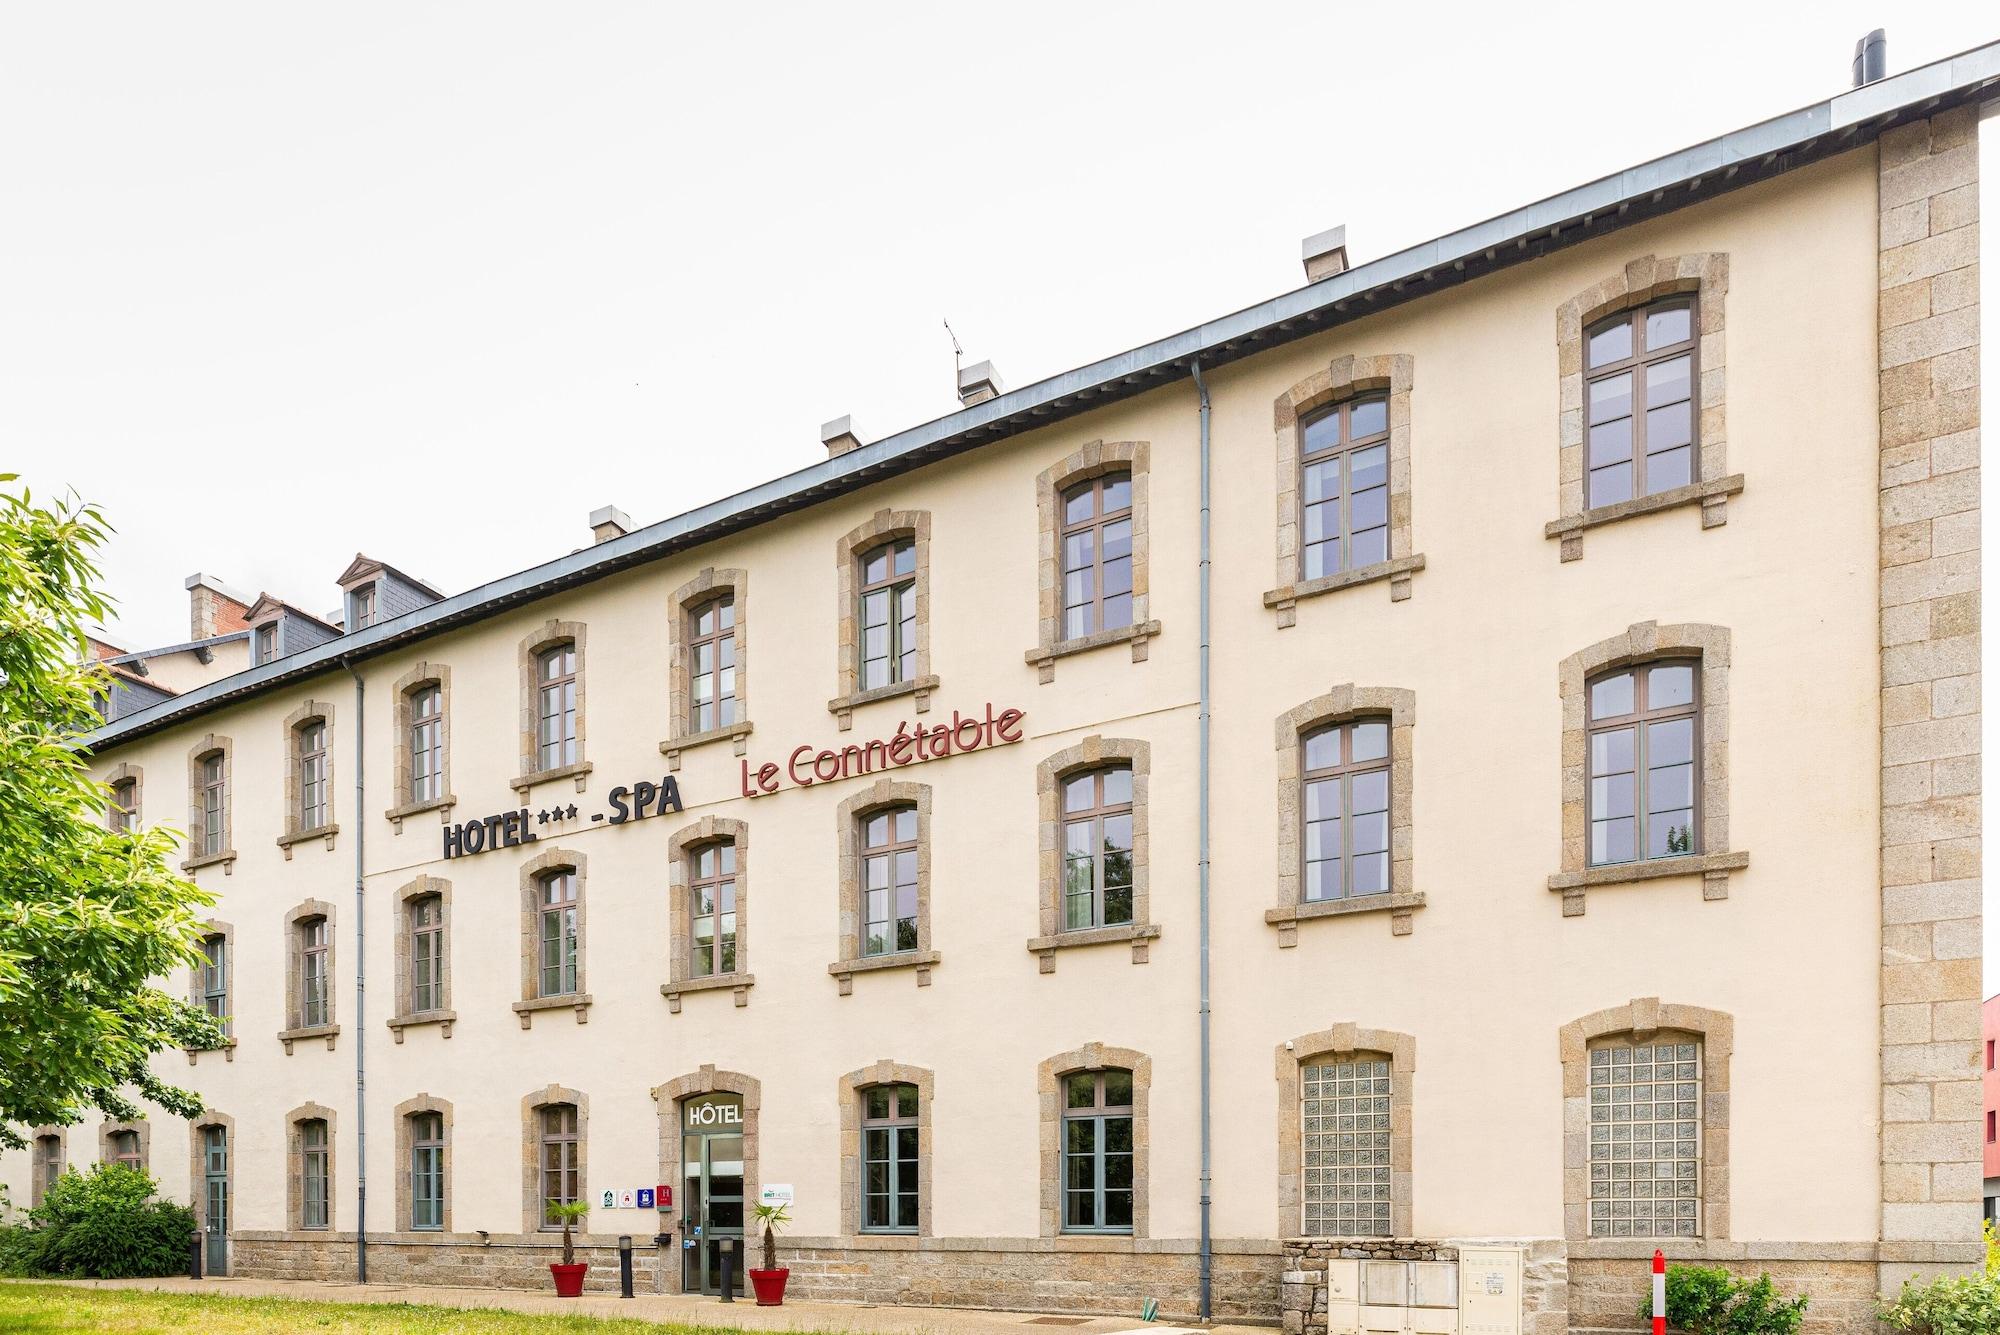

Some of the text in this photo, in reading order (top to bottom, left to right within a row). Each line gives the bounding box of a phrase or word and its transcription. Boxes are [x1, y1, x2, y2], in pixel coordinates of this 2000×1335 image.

[741, 702, 1025, 797] Le Connétable
[443, 808, 537, 860] HOTEL
[690, 1101, 743, 1125] HÔTEL
